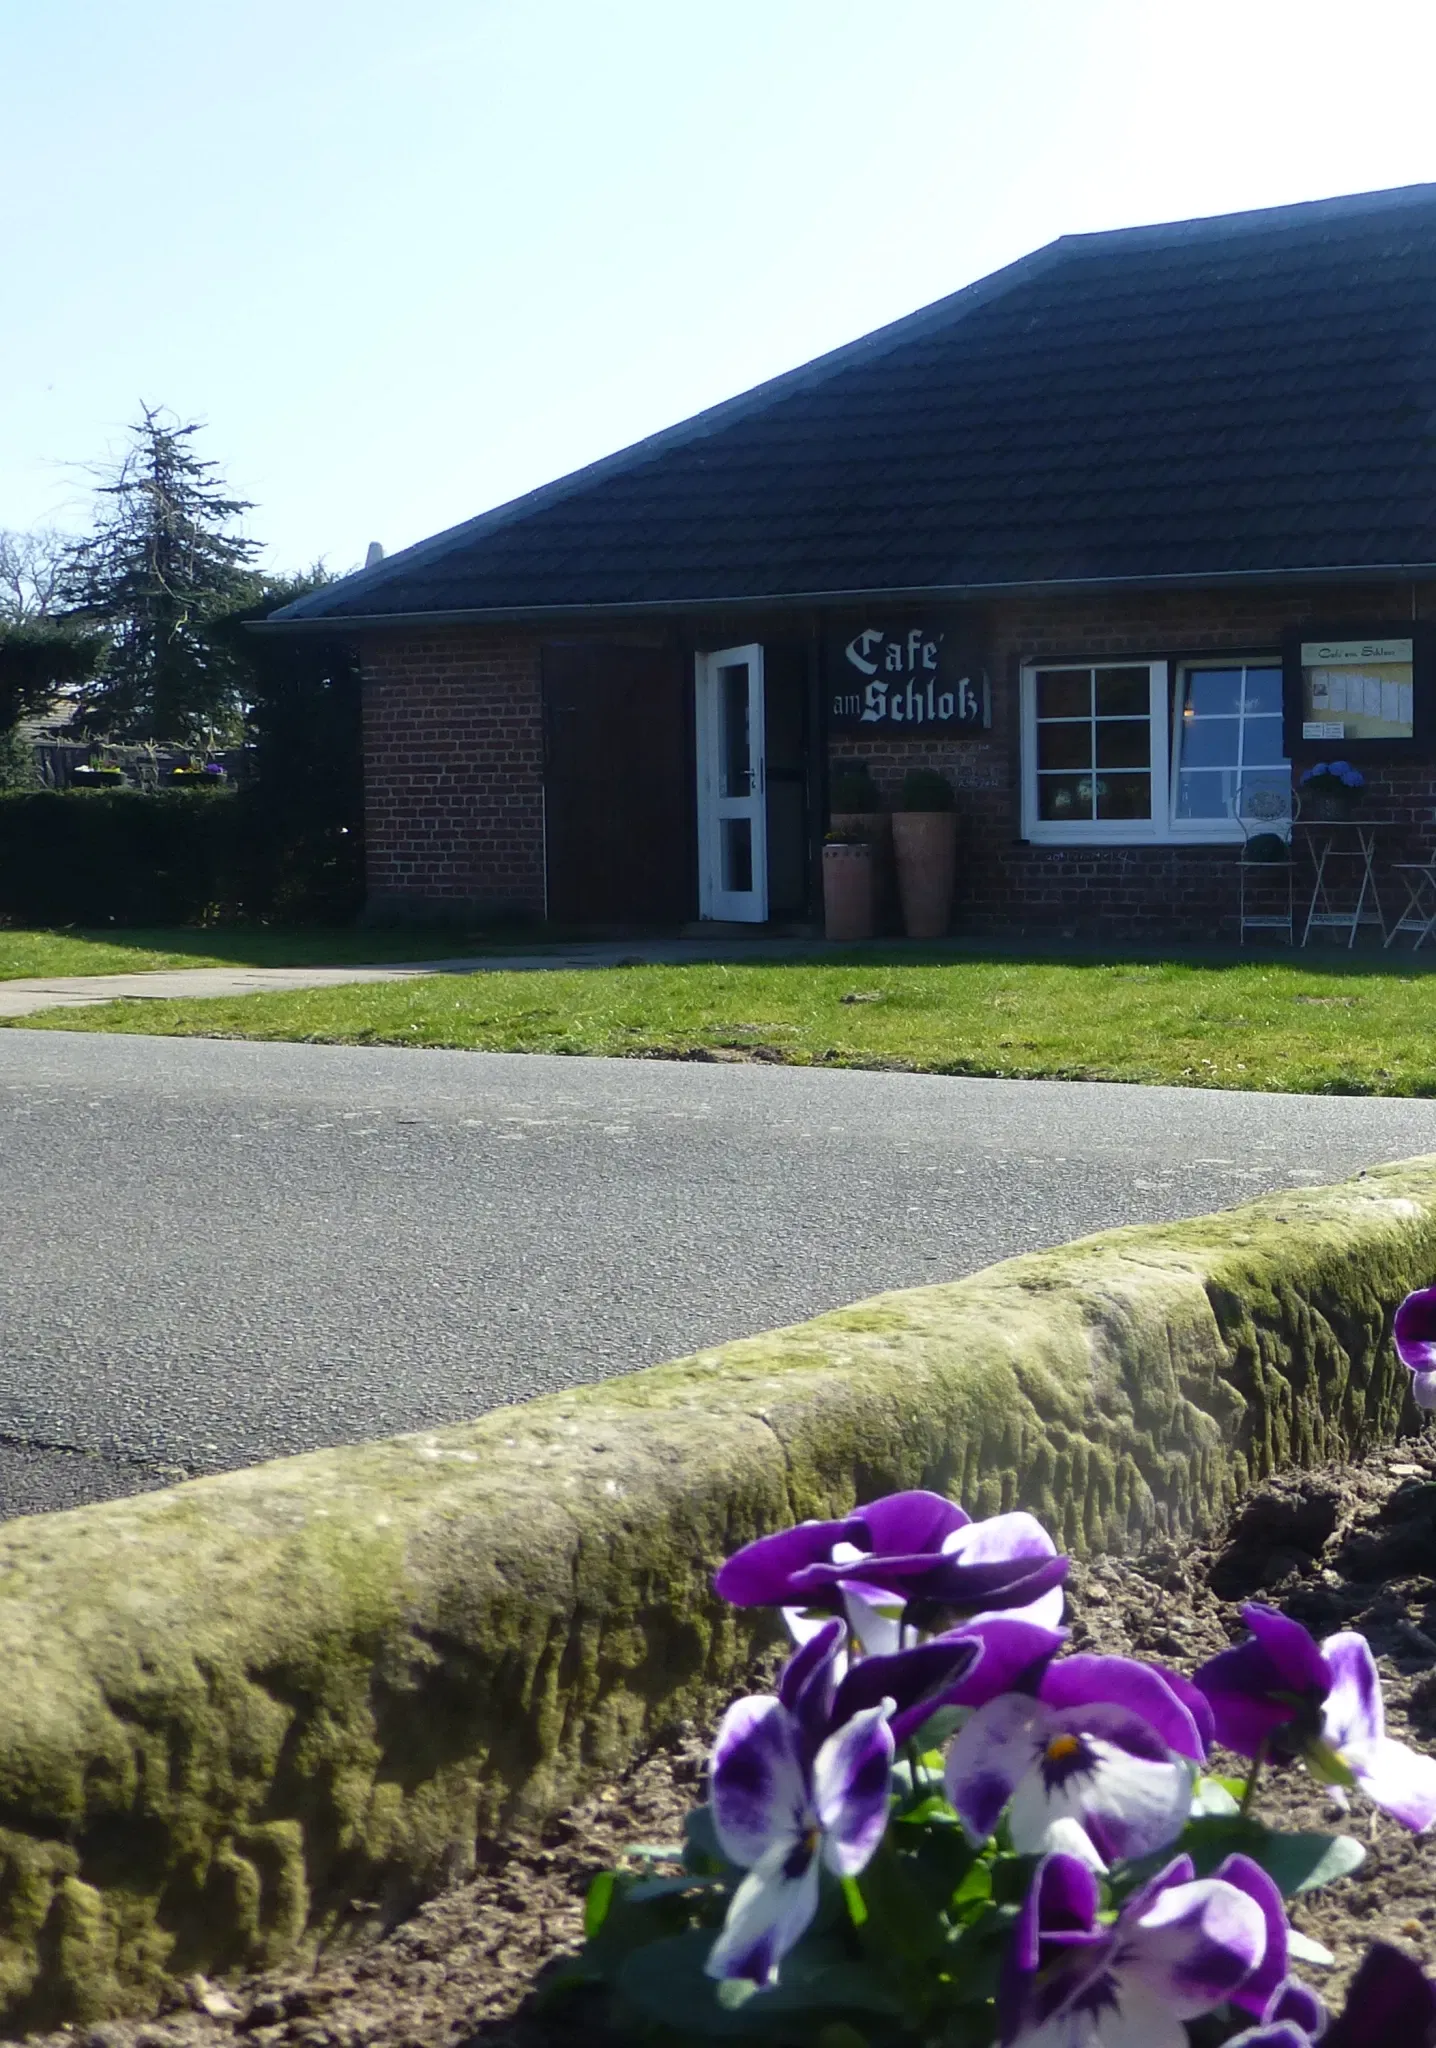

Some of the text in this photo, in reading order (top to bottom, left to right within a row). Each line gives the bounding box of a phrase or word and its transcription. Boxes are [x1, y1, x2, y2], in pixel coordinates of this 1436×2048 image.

[845, 628, 944, 675] Café
[833, 675, 978, 724] am Schloß
